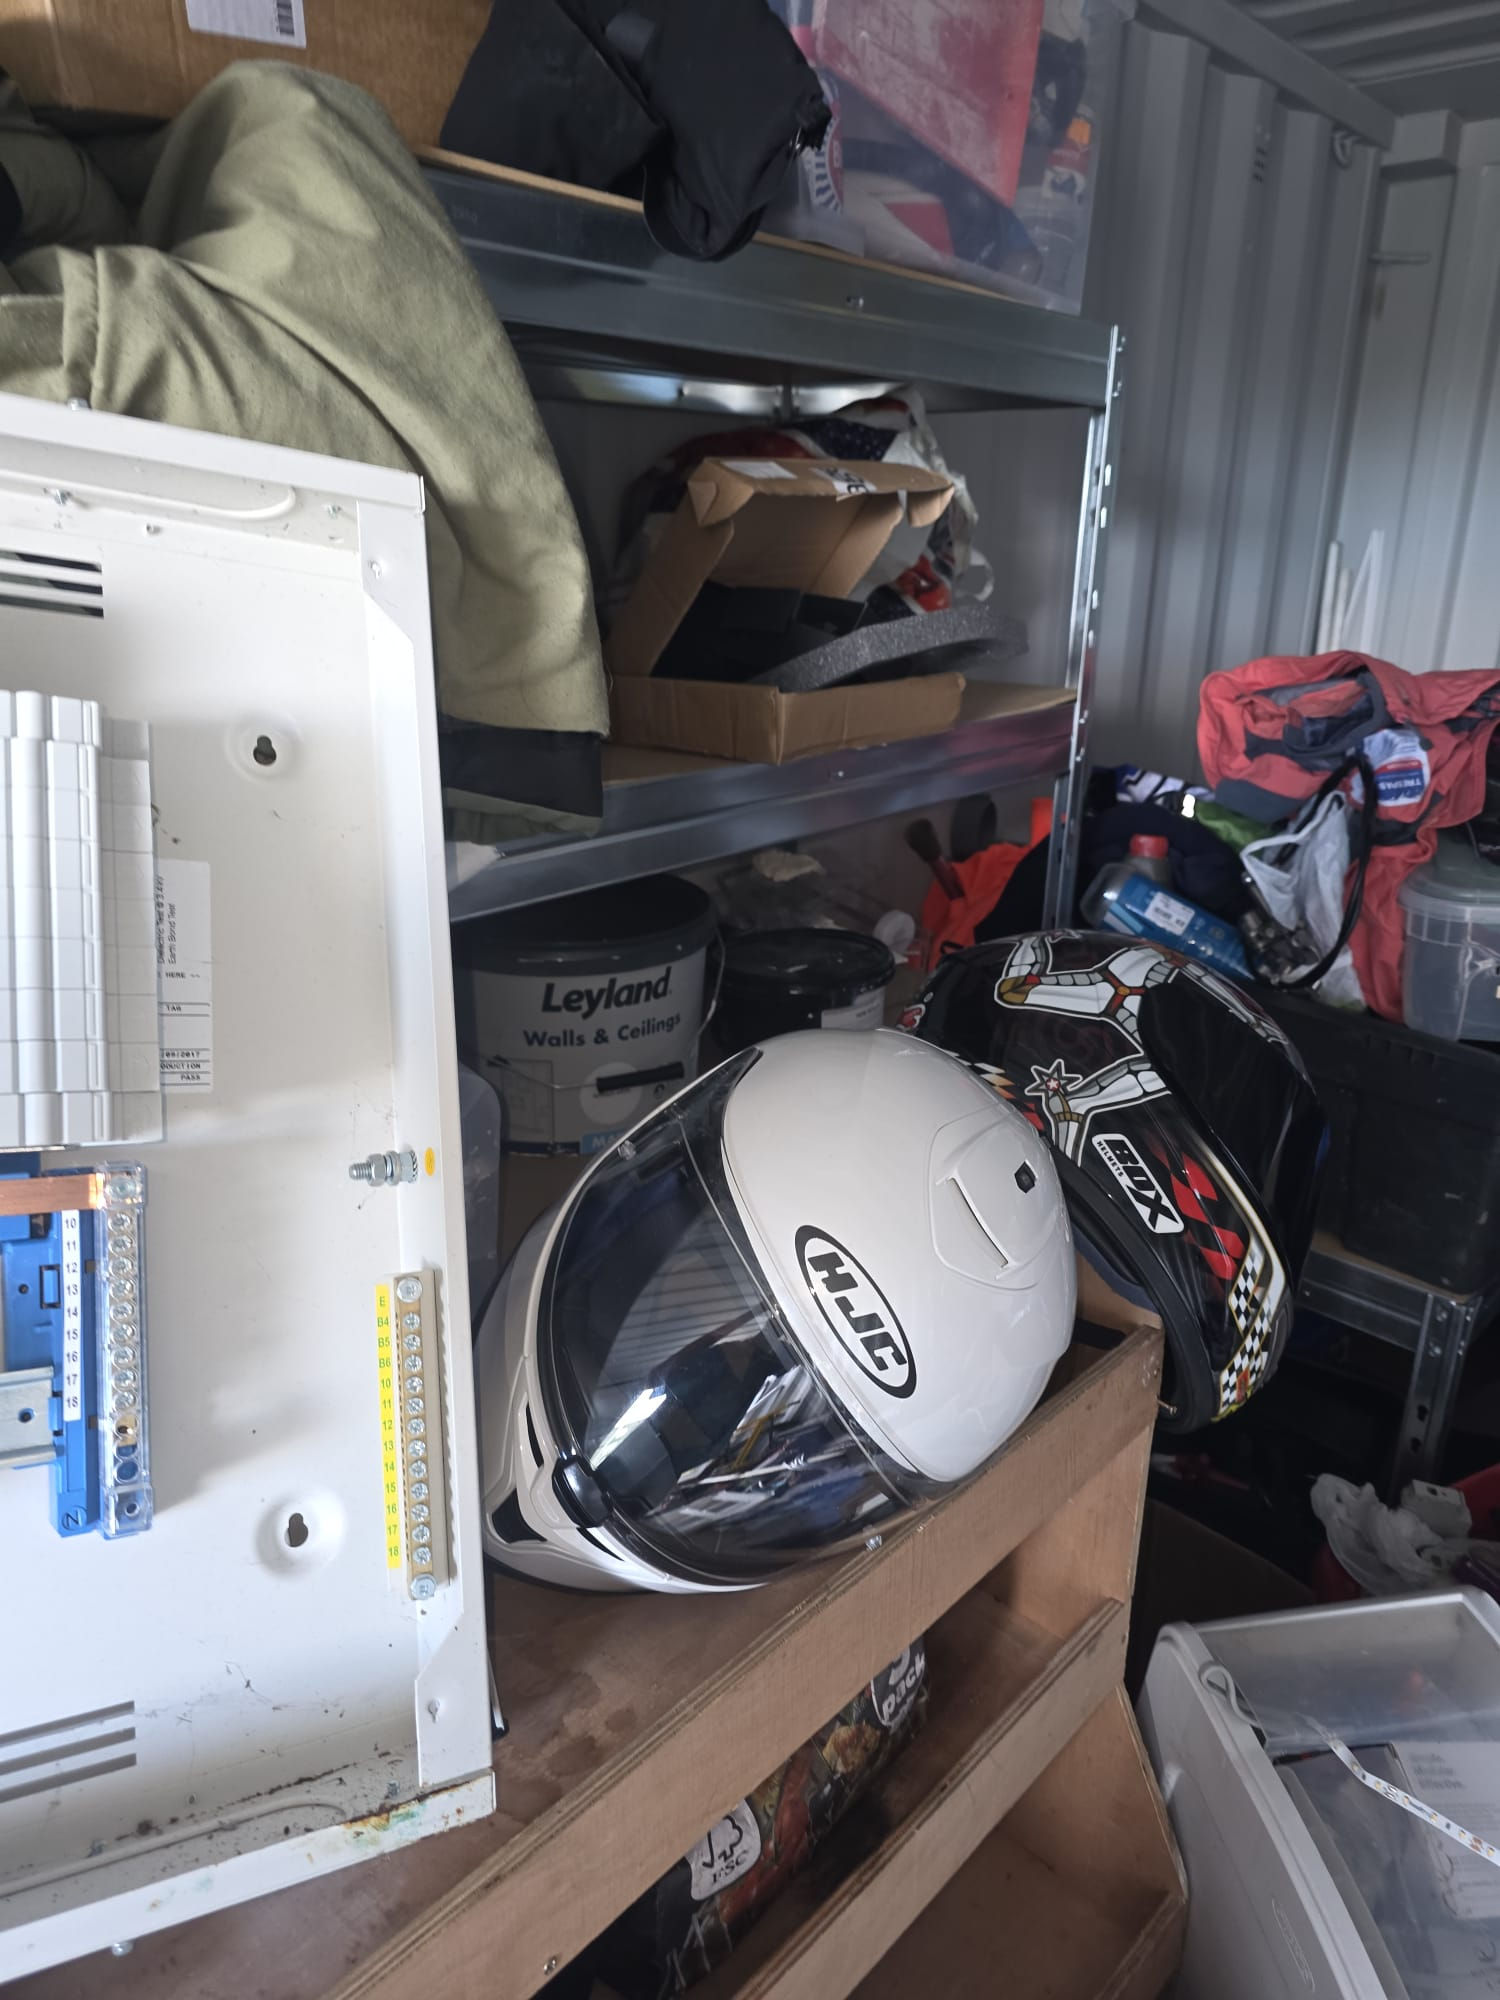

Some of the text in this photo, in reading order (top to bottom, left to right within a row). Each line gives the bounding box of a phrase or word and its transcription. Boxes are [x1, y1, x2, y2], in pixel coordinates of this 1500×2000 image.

[168, 902, 176, 920] Test
[165, 971, 186, 980] HERE
[541, 966, 672, 1020] Leyland
[523, 1013, 681, 1048] Walls & Ceilings
[1096, 1141, 1125, 1178] HELMETS
[65, 1218, 77, 1229] 10
[66, 1240, 77, 1250] 11
[66, 1263, 78, 1273] 12
[66, 1285, 78, 1296] 13
[379, 1296, 386, 1307] E
[66, 1307, 78, 1318] 14
[807, 1251, 908, 1371] HJC
[377, 1316, 389, 1328] B4
[66, 1329, 78, 1341] 15
[378, 1337, 391, 1348] B5
[66, 1351, 78, 1363] 16
[66, 1374, 78, 1386] 17
[381, 1378, 391, 1389] 10
[66, 1396, 78, 1408] 18
[382, 1399, 392, 1409] 11
[382, 1420, 393, 1430] 12
[383, 1440, 394, 1451] 13
[384, 1461, 395, 1472] 14
[385, 1482, 396, 1493] 15
[386, 1503, 397, 1514] 16
[387, 1524, 398, 1536] 17
[388, 1545, 399, 1557] 18
[882, 1652, 926, 1723] pack
